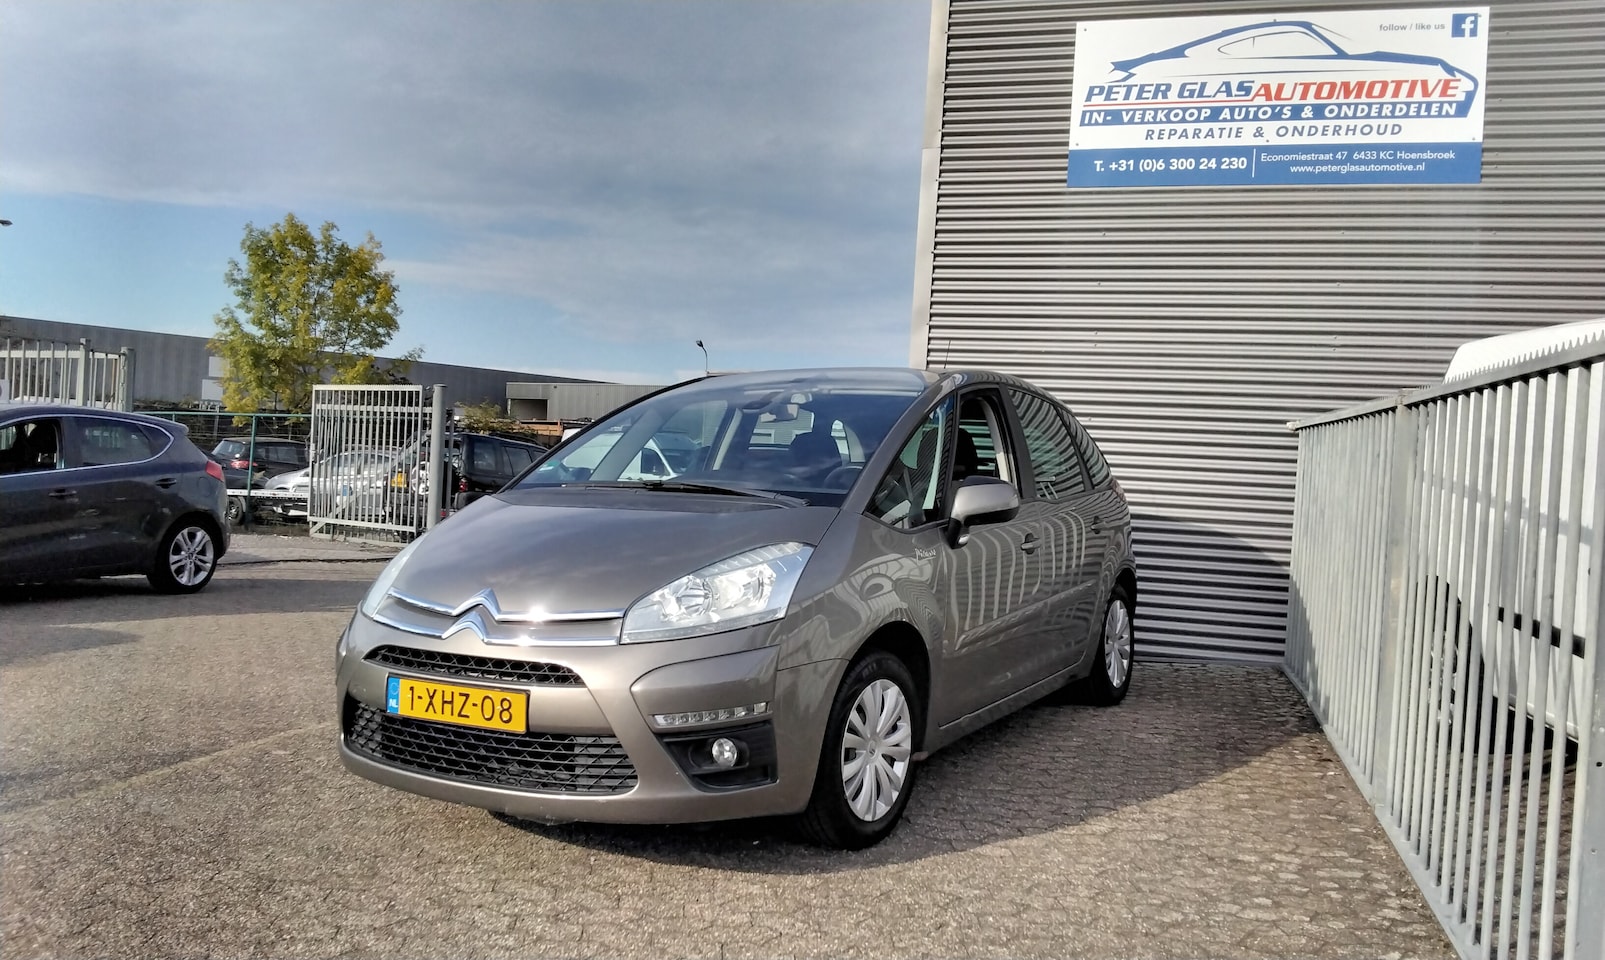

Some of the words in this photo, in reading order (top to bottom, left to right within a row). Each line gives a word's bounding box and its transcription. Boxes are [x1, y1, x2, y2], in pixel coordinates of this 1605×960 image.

[1379, 23, 1407, 31] follow
[1415, 22, 1432, 30] like
[1084, 83, 1172, 103] PETER
[1084, 111, 1112, 124] IN-
[1121, 108, 1211, 123] VERKOOP
[1218, 103, 1293, 121] AUTO'S
[1301, 104, 1314, 119] &
[1324, 102, 1457, 118] ONDERDELEN
[1145, 126, 1244, 140] REPARATIE
[1252, 126, 1265, 138] &
[1275, 123, 1403, 138] ONDERHOUD
[1261, 152, 1333, 162] Economiestraat
[1335, 152, 1347, 160] 47
[1352, 151, 1377, 160] 6433
[1379, 150, 1394, 160] KC
[1396, 150, 1456, 160] Hoensbroek
[1094, 160, 1105, 172] T.
[1109, 160, 1134, 172] +31
[1139, 158, 1165, 173] (0)6
[1169, 158, 1196, 170] 300
[1199, 158, 1217, 170] 24
[1220, 157, 1248, 169] 230
[1290, 162, 1425, 174] www.peterglasautomotive.nl
[409, 686, 513, 724] 1-XHZ-08
